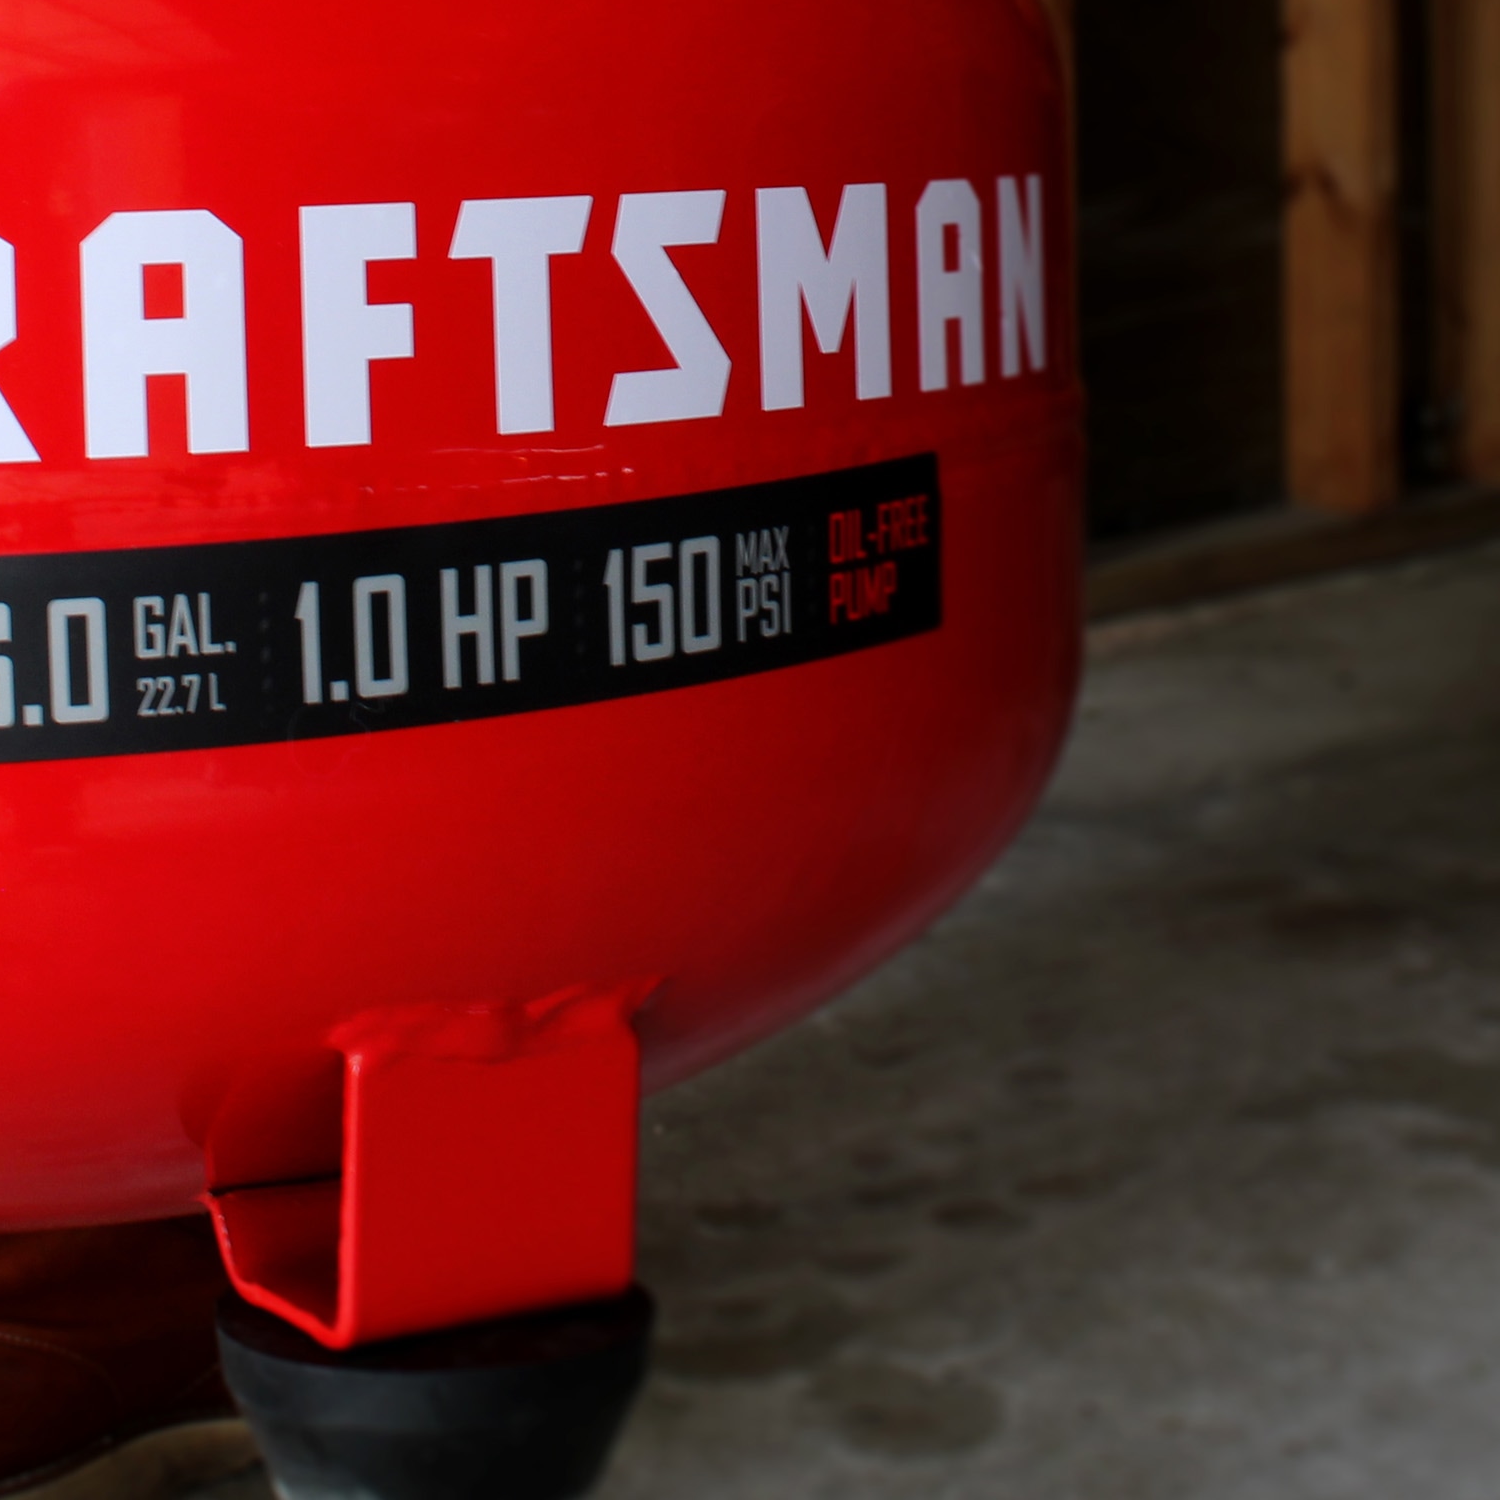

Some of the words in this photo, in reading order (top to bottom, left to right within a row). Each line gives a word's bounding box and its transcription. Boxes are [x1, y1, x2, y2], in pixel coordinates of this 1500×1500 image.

[735, 526, 790, 574] MAX
[828, 494, 930, 563] OIL-FREE
[132, 592, 237, 660] GAL.
[603, 535, 722, 666] 150
[736, 571, 792, 643] PSI
[828, 561, 898, 626] PUMP
[294, 573, 410, 704] 1.0
[440, 558, 549, 689] HP
